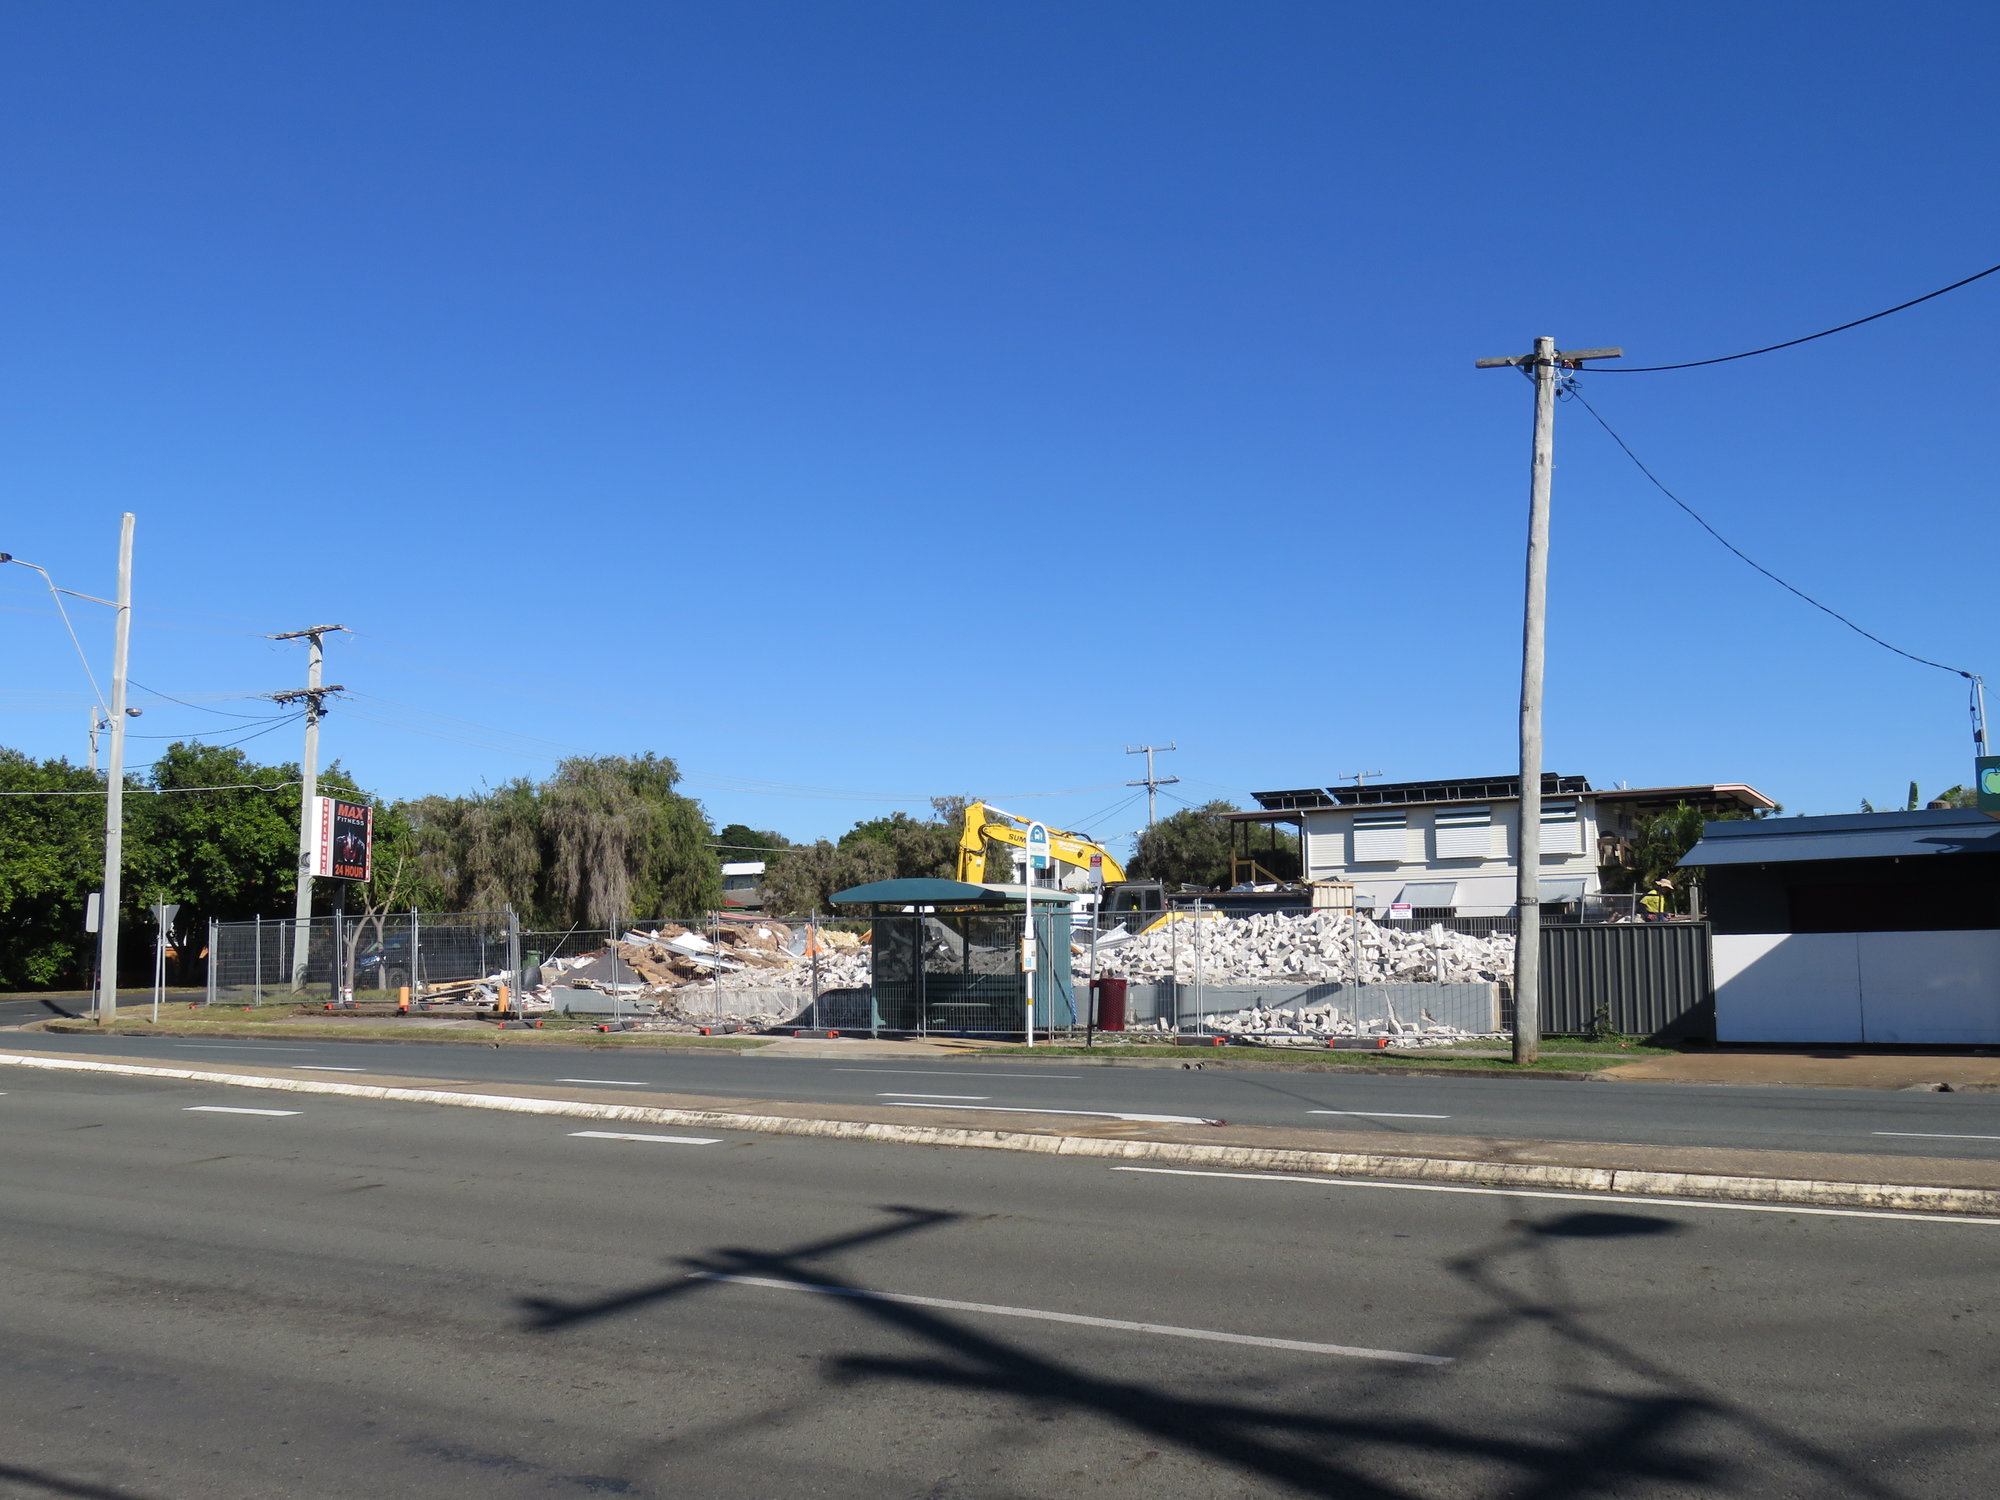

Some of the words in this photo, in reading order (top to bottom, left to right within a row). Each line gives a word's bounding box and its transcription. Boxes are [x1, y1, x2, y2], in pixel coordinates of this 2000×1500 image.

[338, 803, 365, 820] MAX
[337, 815, 365, 826] FITNESS
[335, 864, 344, 875] 24
[344, 865, 364, 878] HOUR
